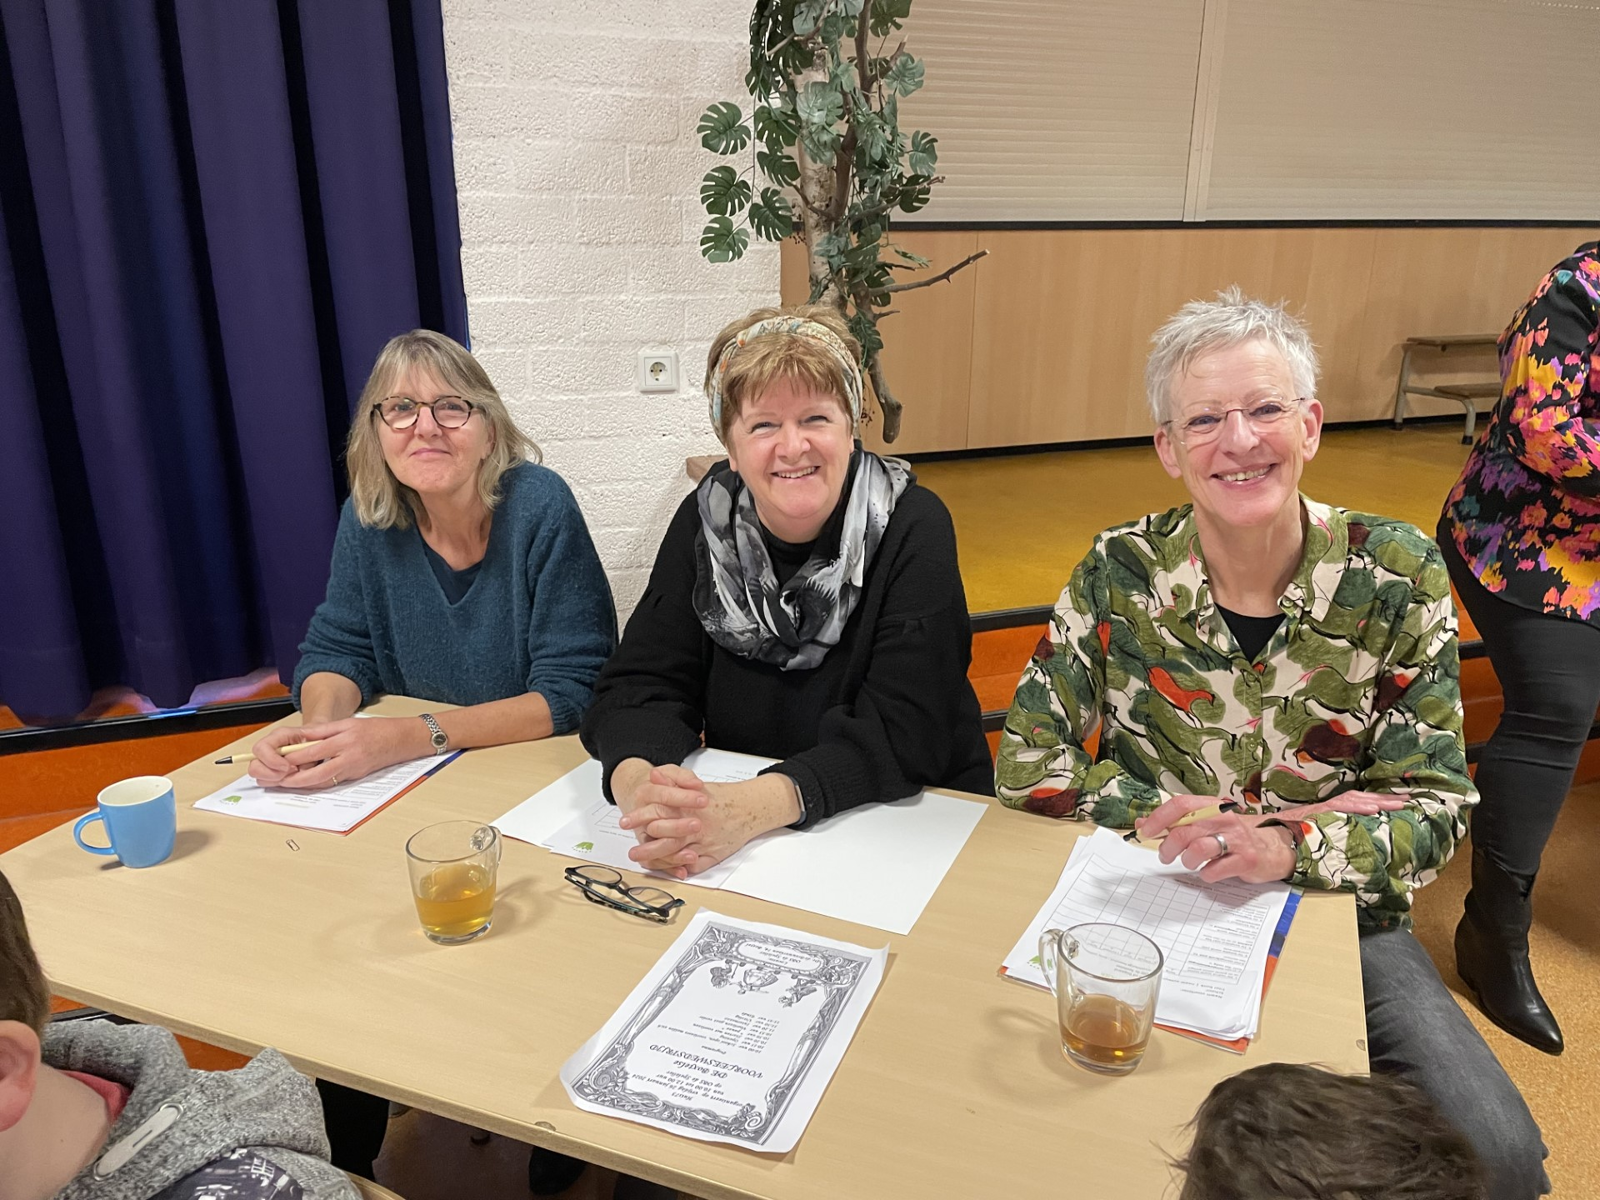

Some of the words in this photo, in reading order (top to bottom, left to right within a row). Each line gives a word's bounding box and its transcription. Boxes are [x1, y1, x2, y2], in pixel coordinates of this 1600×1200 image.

[650, 1044, 763, 1079] VOORLEESWEDSTRIJD
[673, 1060, 710, 1074] Boxtelse
[710, 1070, 728, 1079] DE
[646, 1078, 670, 1087] januari
[677, 1086, 699, 1095] vrijdag
[710, 1096, 743, 1107] organiseert
